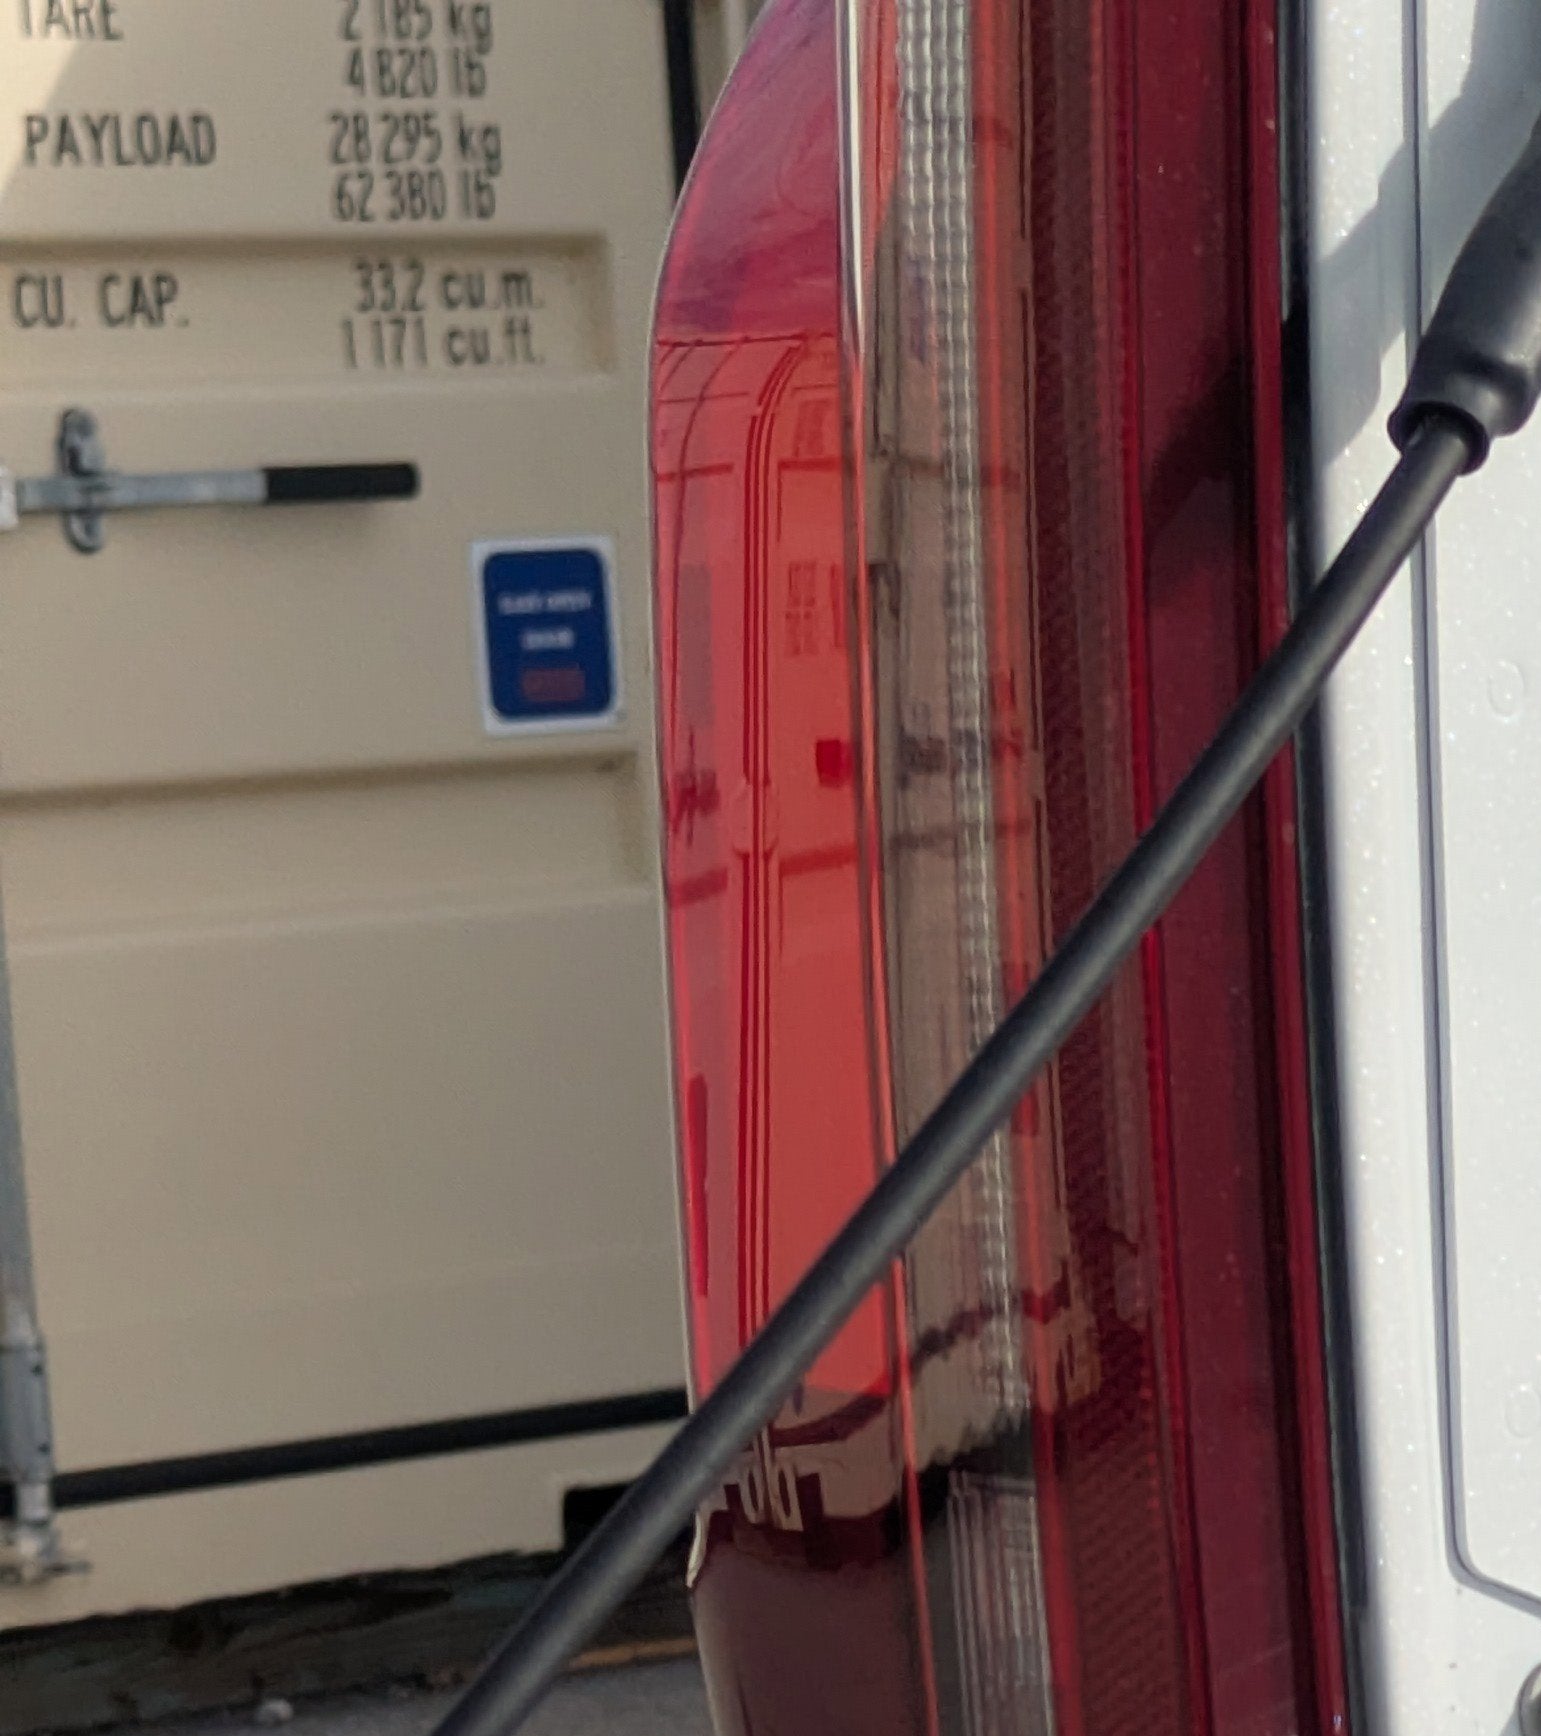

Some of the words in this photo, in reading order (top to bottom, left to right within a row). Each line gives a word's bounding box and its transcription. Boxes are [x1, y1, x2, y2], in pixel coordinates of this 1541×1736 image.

[447, 0, 494, 55] kg
[24, 111, 217, 166] PAYLOAD
[456, 108, 502, 178] kg
[98, 270, 191, 329] CAP.
